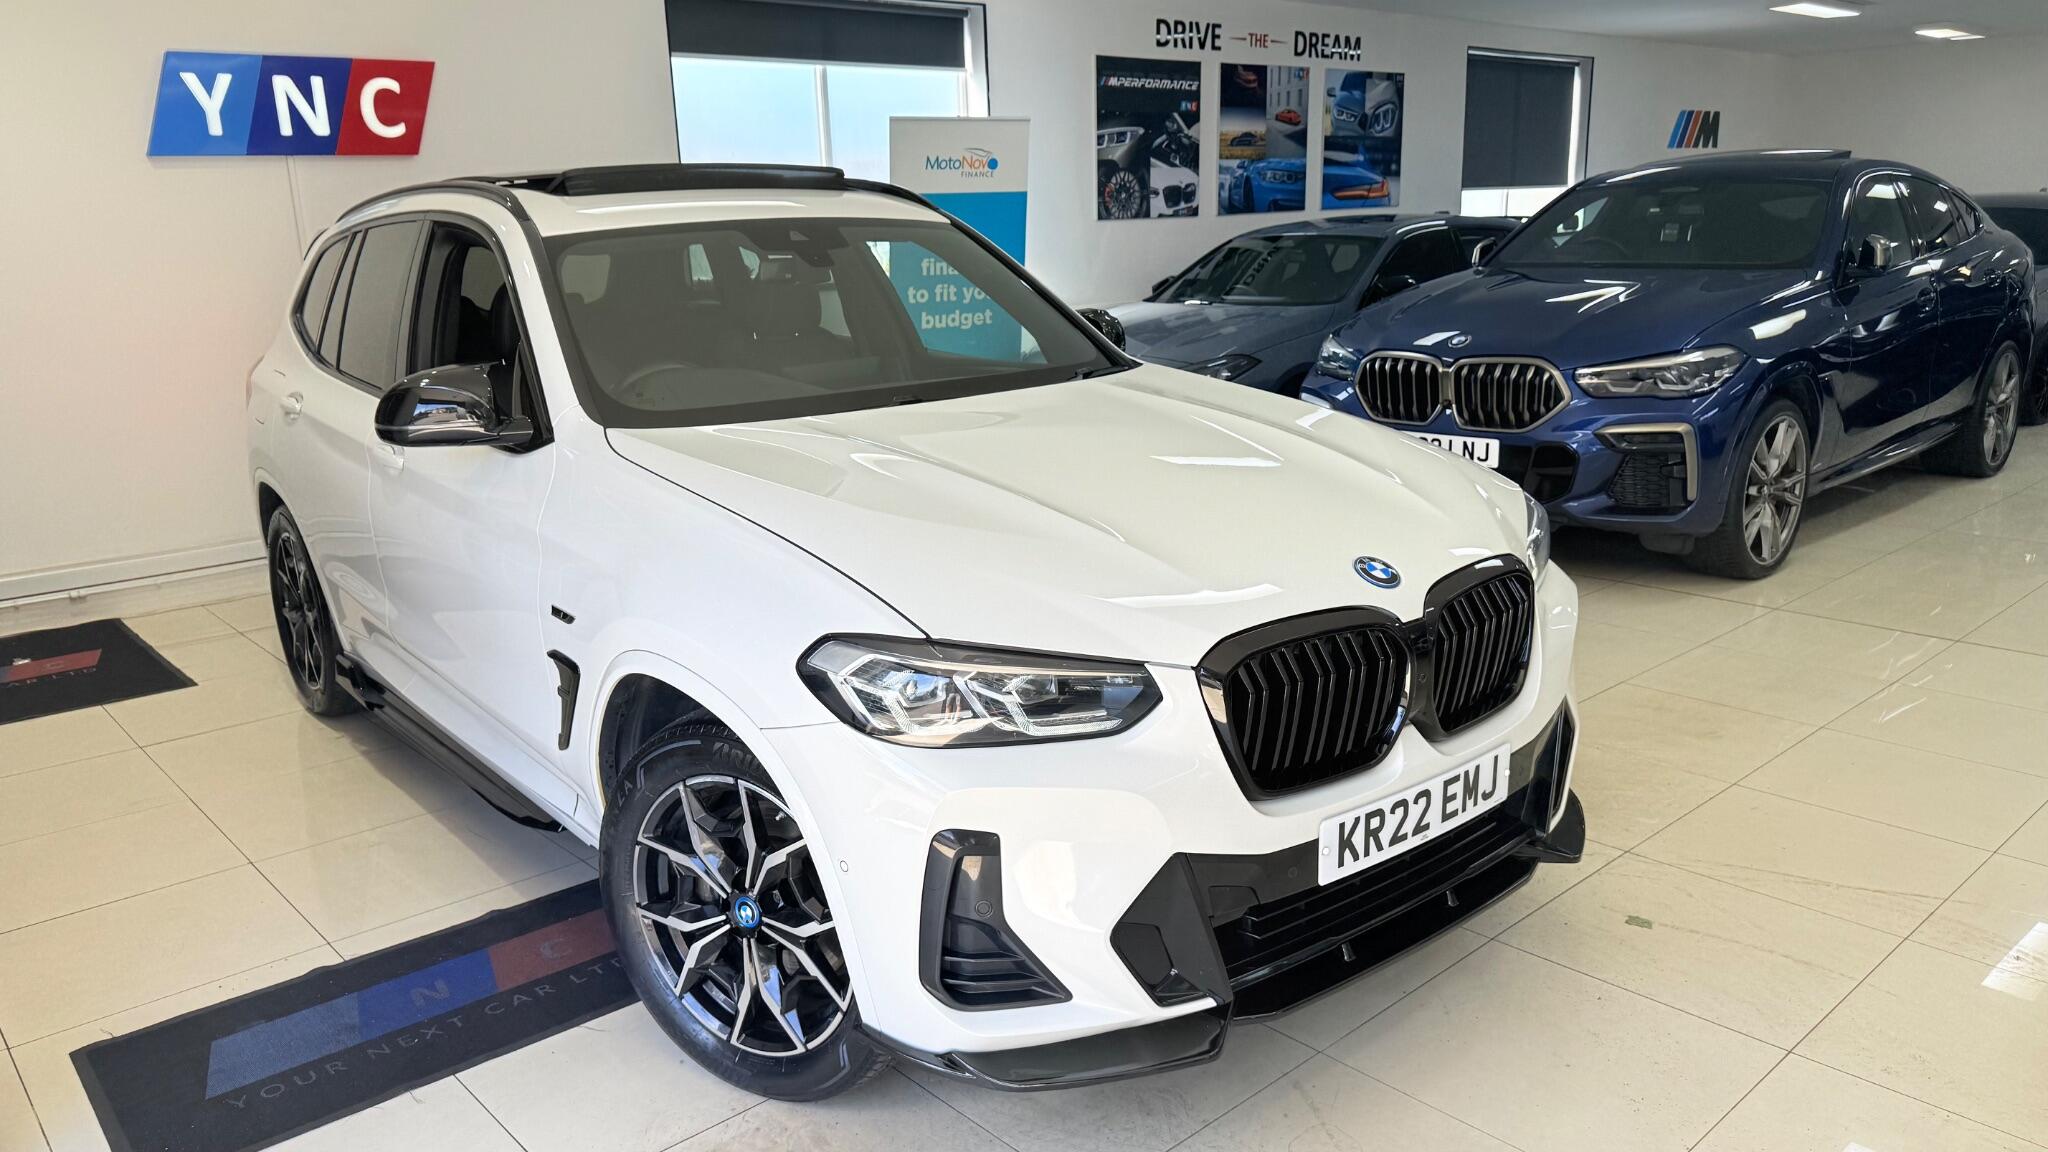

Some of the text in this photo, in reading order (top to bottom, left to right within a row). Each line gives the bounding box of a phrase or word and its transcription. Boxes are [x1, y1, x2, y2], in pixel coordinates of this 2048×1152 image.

[1156, 18, 1361, 61] DRIVE THE DREAM
[179, 71, 407, 138] YNC
[961, 170, 994, 178] FINANCE
[907, 284, 991, 304] to fit yo
[921, 309, 993, 330] budget
[224, 1060, 351, 1110] YOUR
[365, 1013, 466, 1061] NEXT
[484, 983, 560, 1016] CAR
